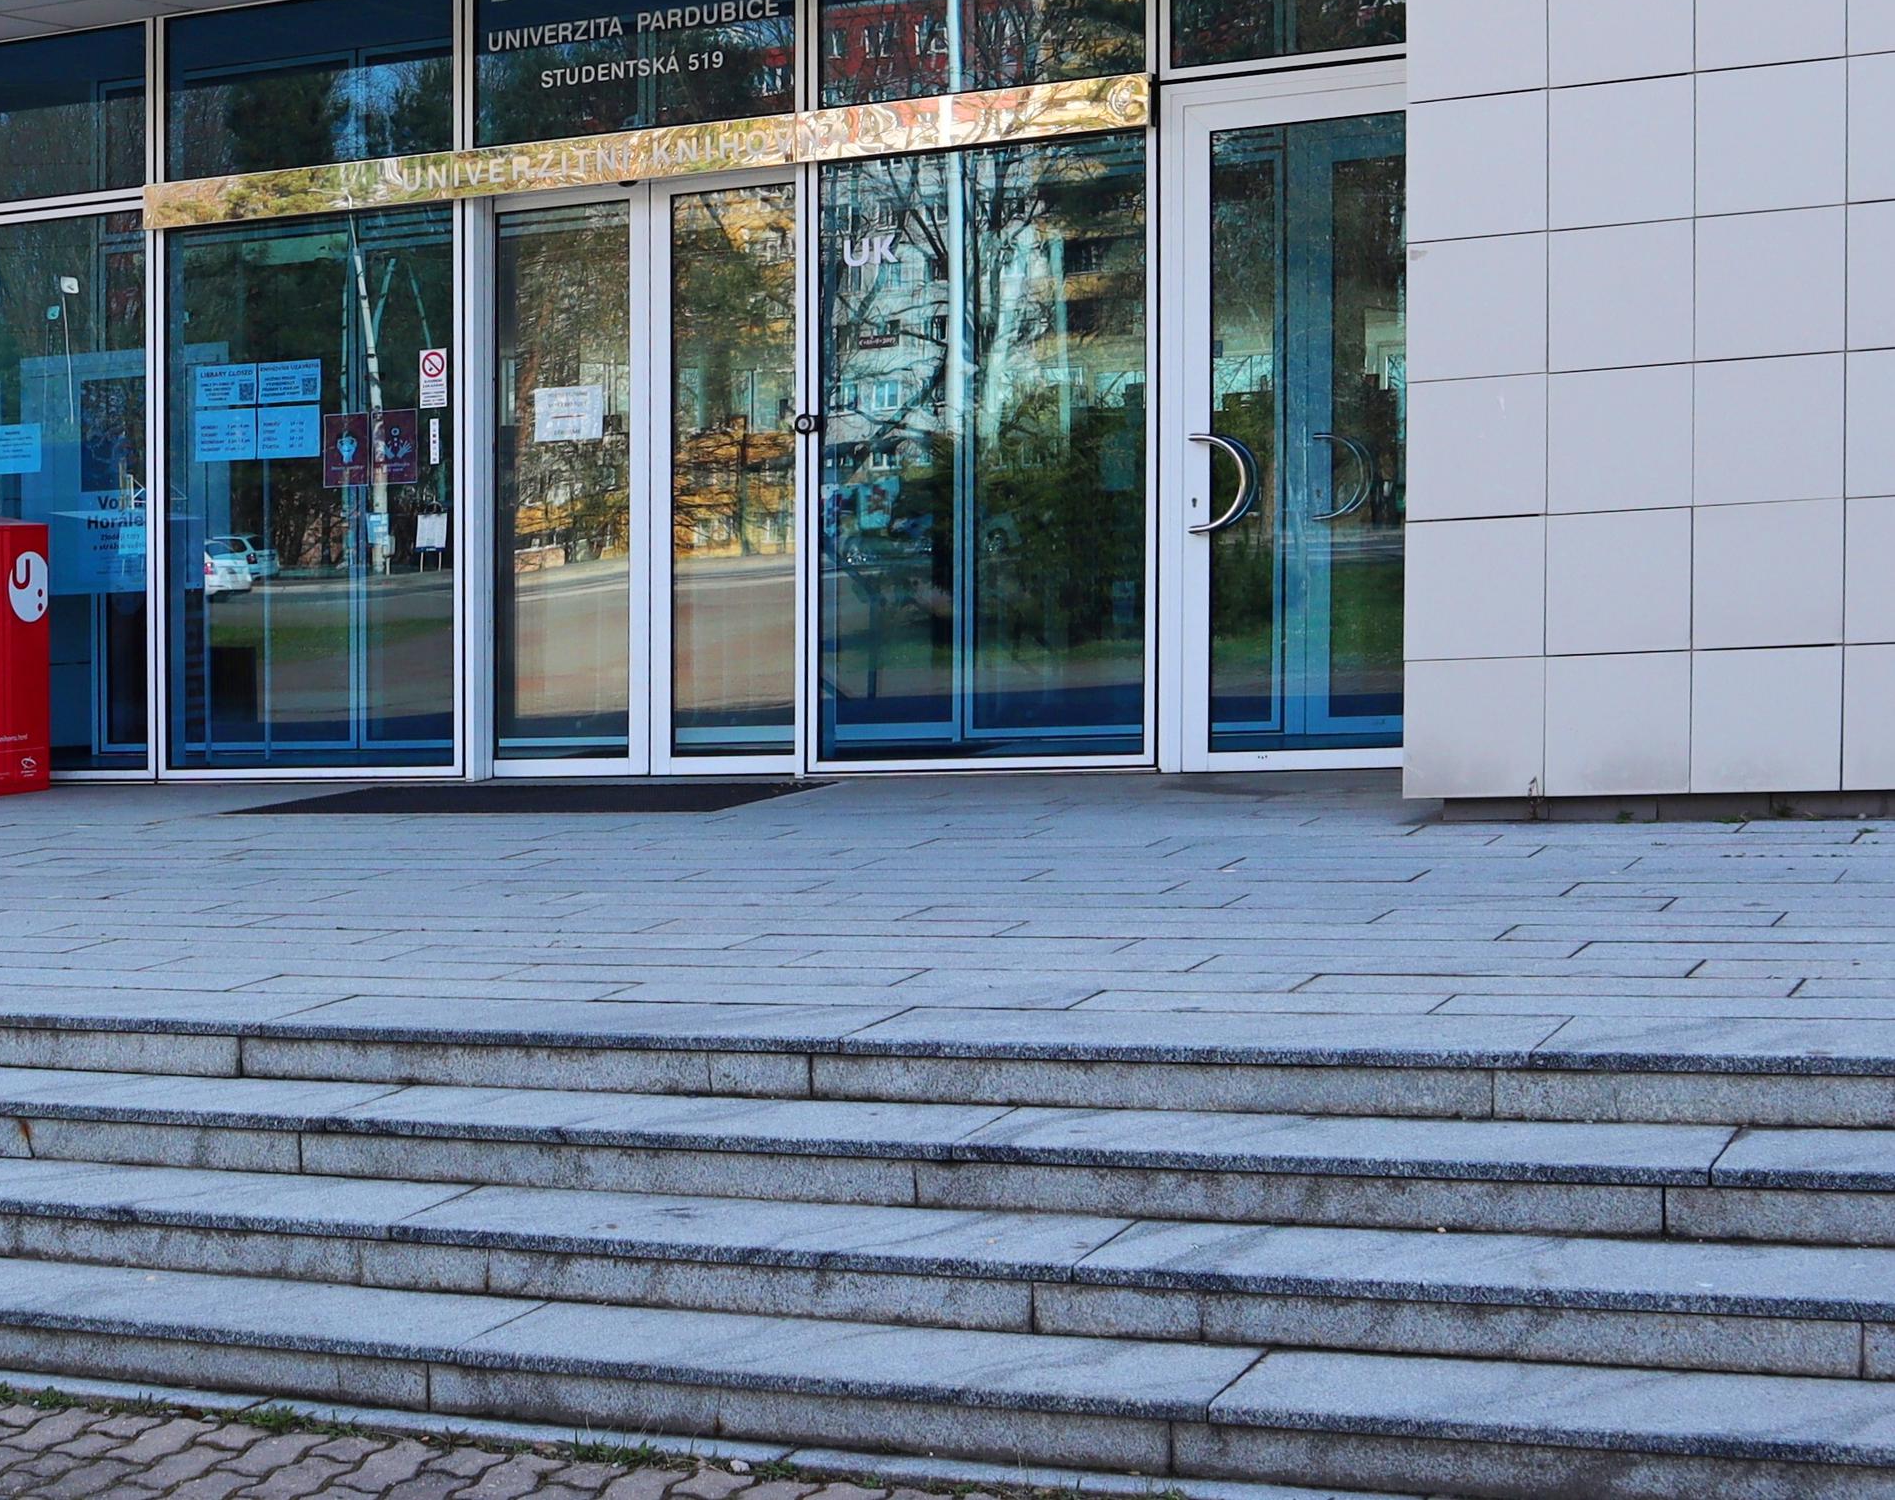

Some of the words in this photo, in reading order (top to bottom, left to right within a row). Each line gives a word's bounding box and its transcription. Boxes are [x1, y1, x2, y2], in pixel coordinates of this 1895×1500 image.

[487, 15, 624, 52] UNIVERZITA
[540, 50, 681, 89] STUDENTSKÁ
[688, 50, 725, 72] 519
[402, 140, 632, 192] UNIVERZITNÍ
[843, 234, 900, 267] UK
[87, 511, 145, 530] Horále
